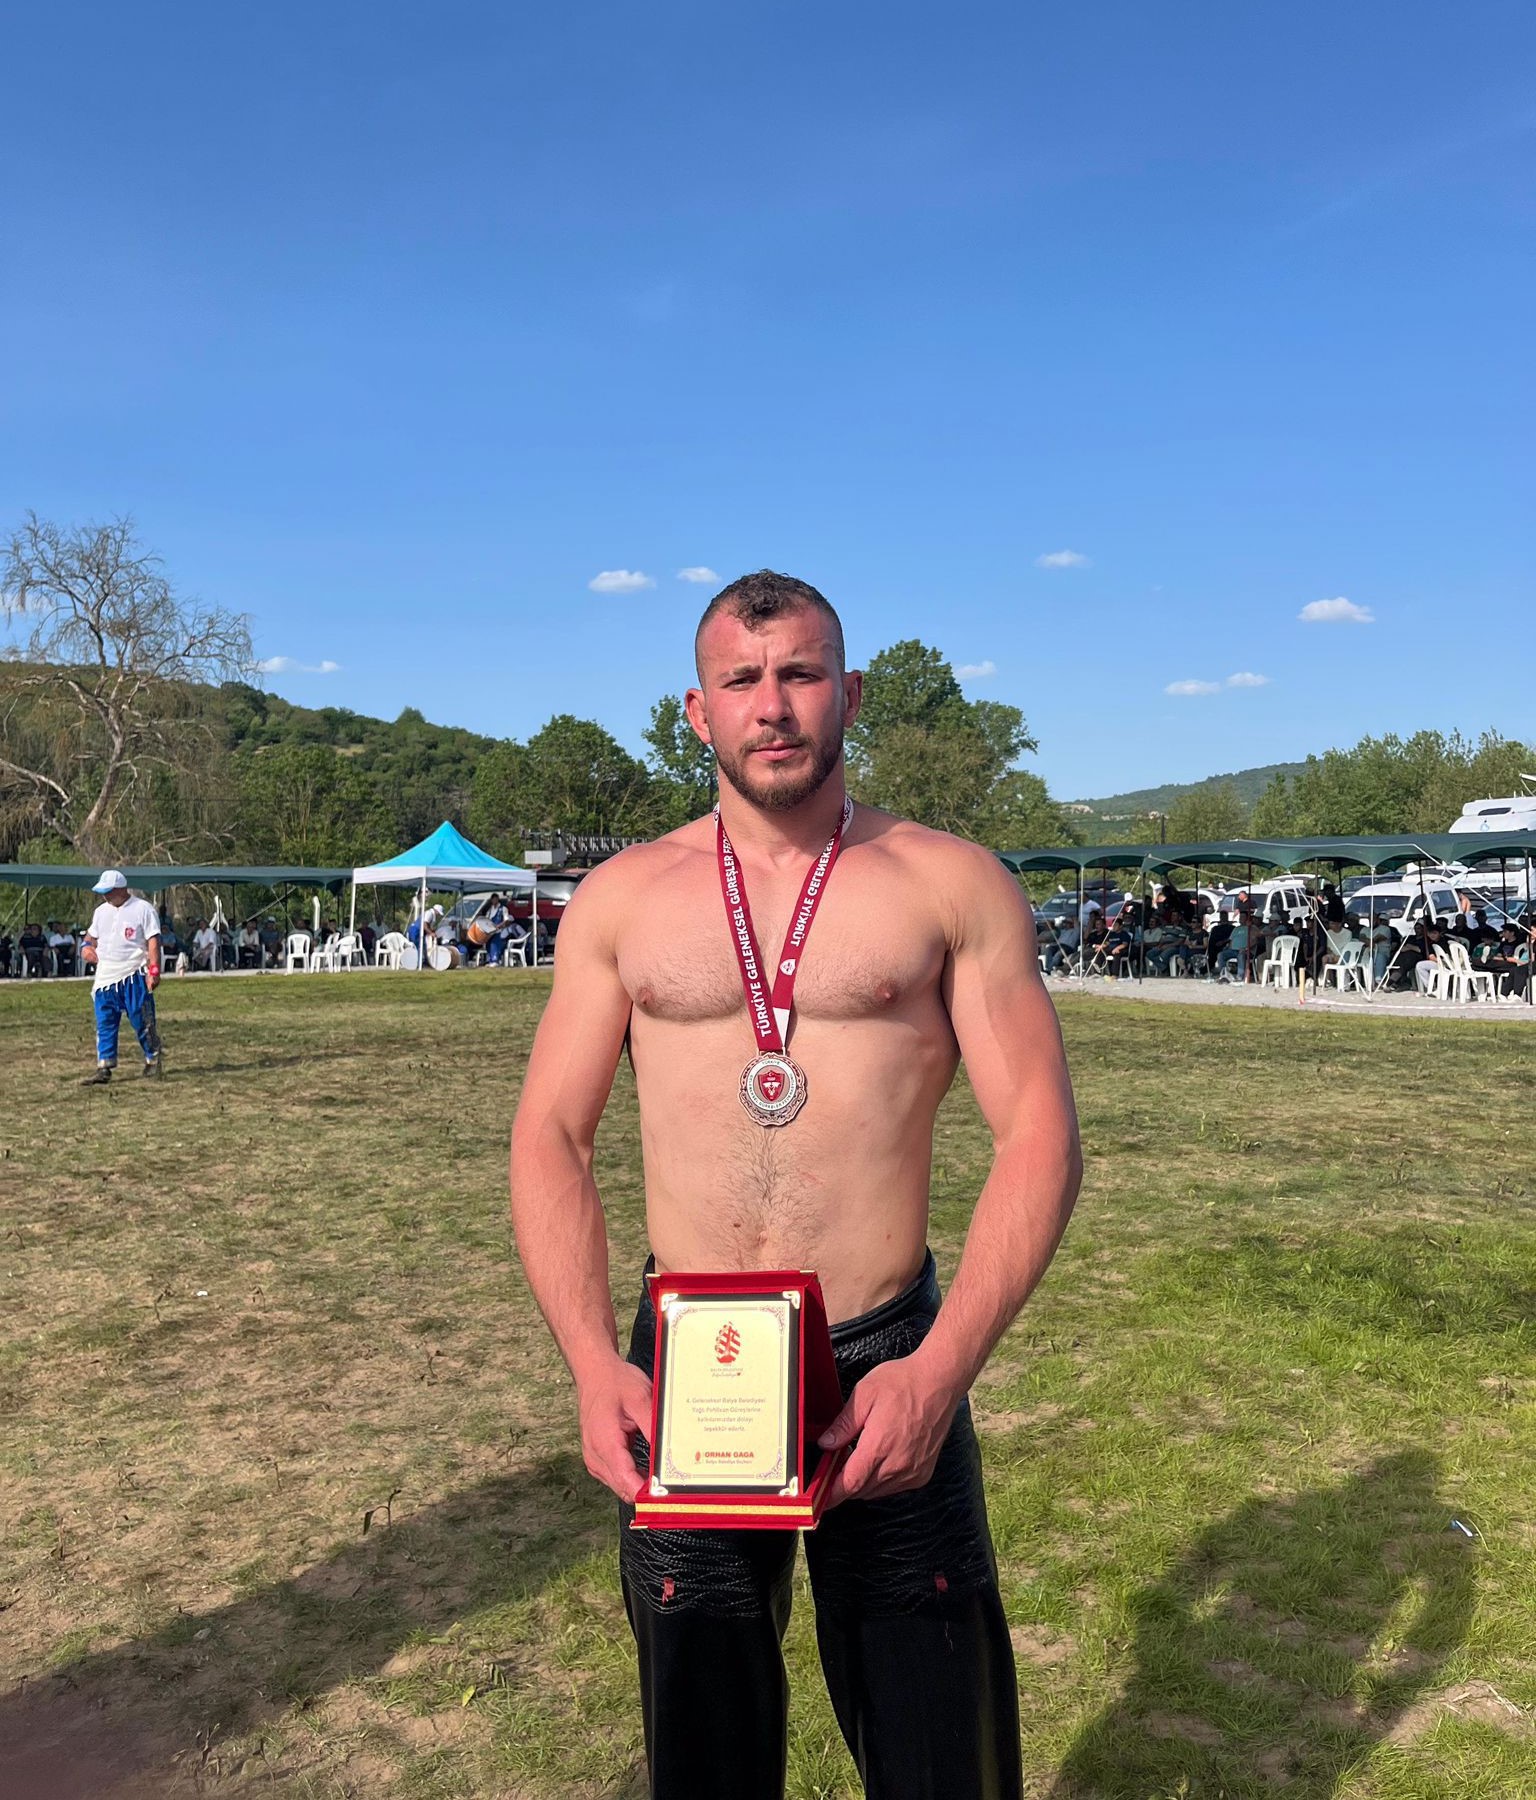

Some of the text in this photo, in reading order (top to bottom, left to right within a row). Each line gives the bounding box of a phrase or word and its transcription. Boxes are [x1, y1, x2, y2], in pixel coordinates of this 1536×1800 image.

[724, 855, 740, 905] GÜREŞLER
[733, 906, 758, 980] GELENEKSEL
[750, 981, 772, 1037] TÜRKİYE
